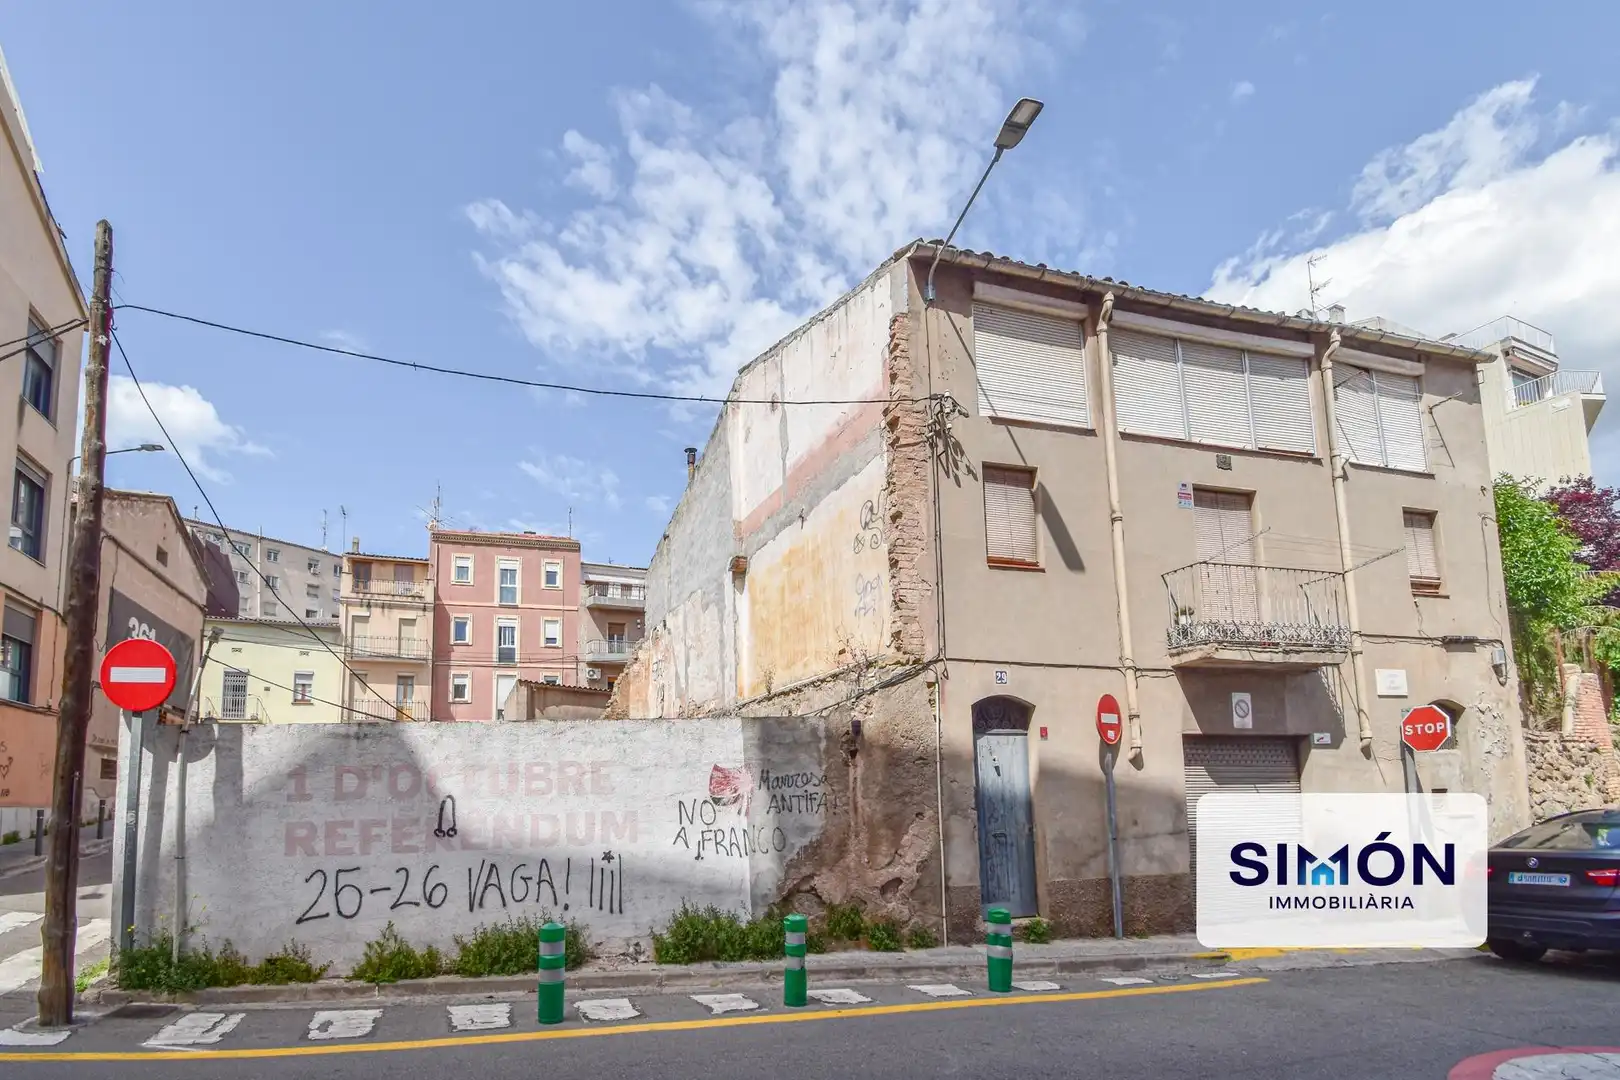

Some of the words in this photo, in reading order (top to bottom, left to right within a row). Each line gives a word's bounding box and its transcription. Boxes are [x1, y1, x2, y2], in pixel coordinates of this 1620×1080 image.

[996, 671, 1007, 684] 29
[1405, 722, 1445, 736] STOP
[286, 763, 314, 802] 1
[678, 798, 717, 825] NO
[284, 810, 639, 857] REFERENDUM
[672, 826, 690, 849] A
[295, 864, 449, 924] 25-26
[467, 857, 569, 912] VAGA!
